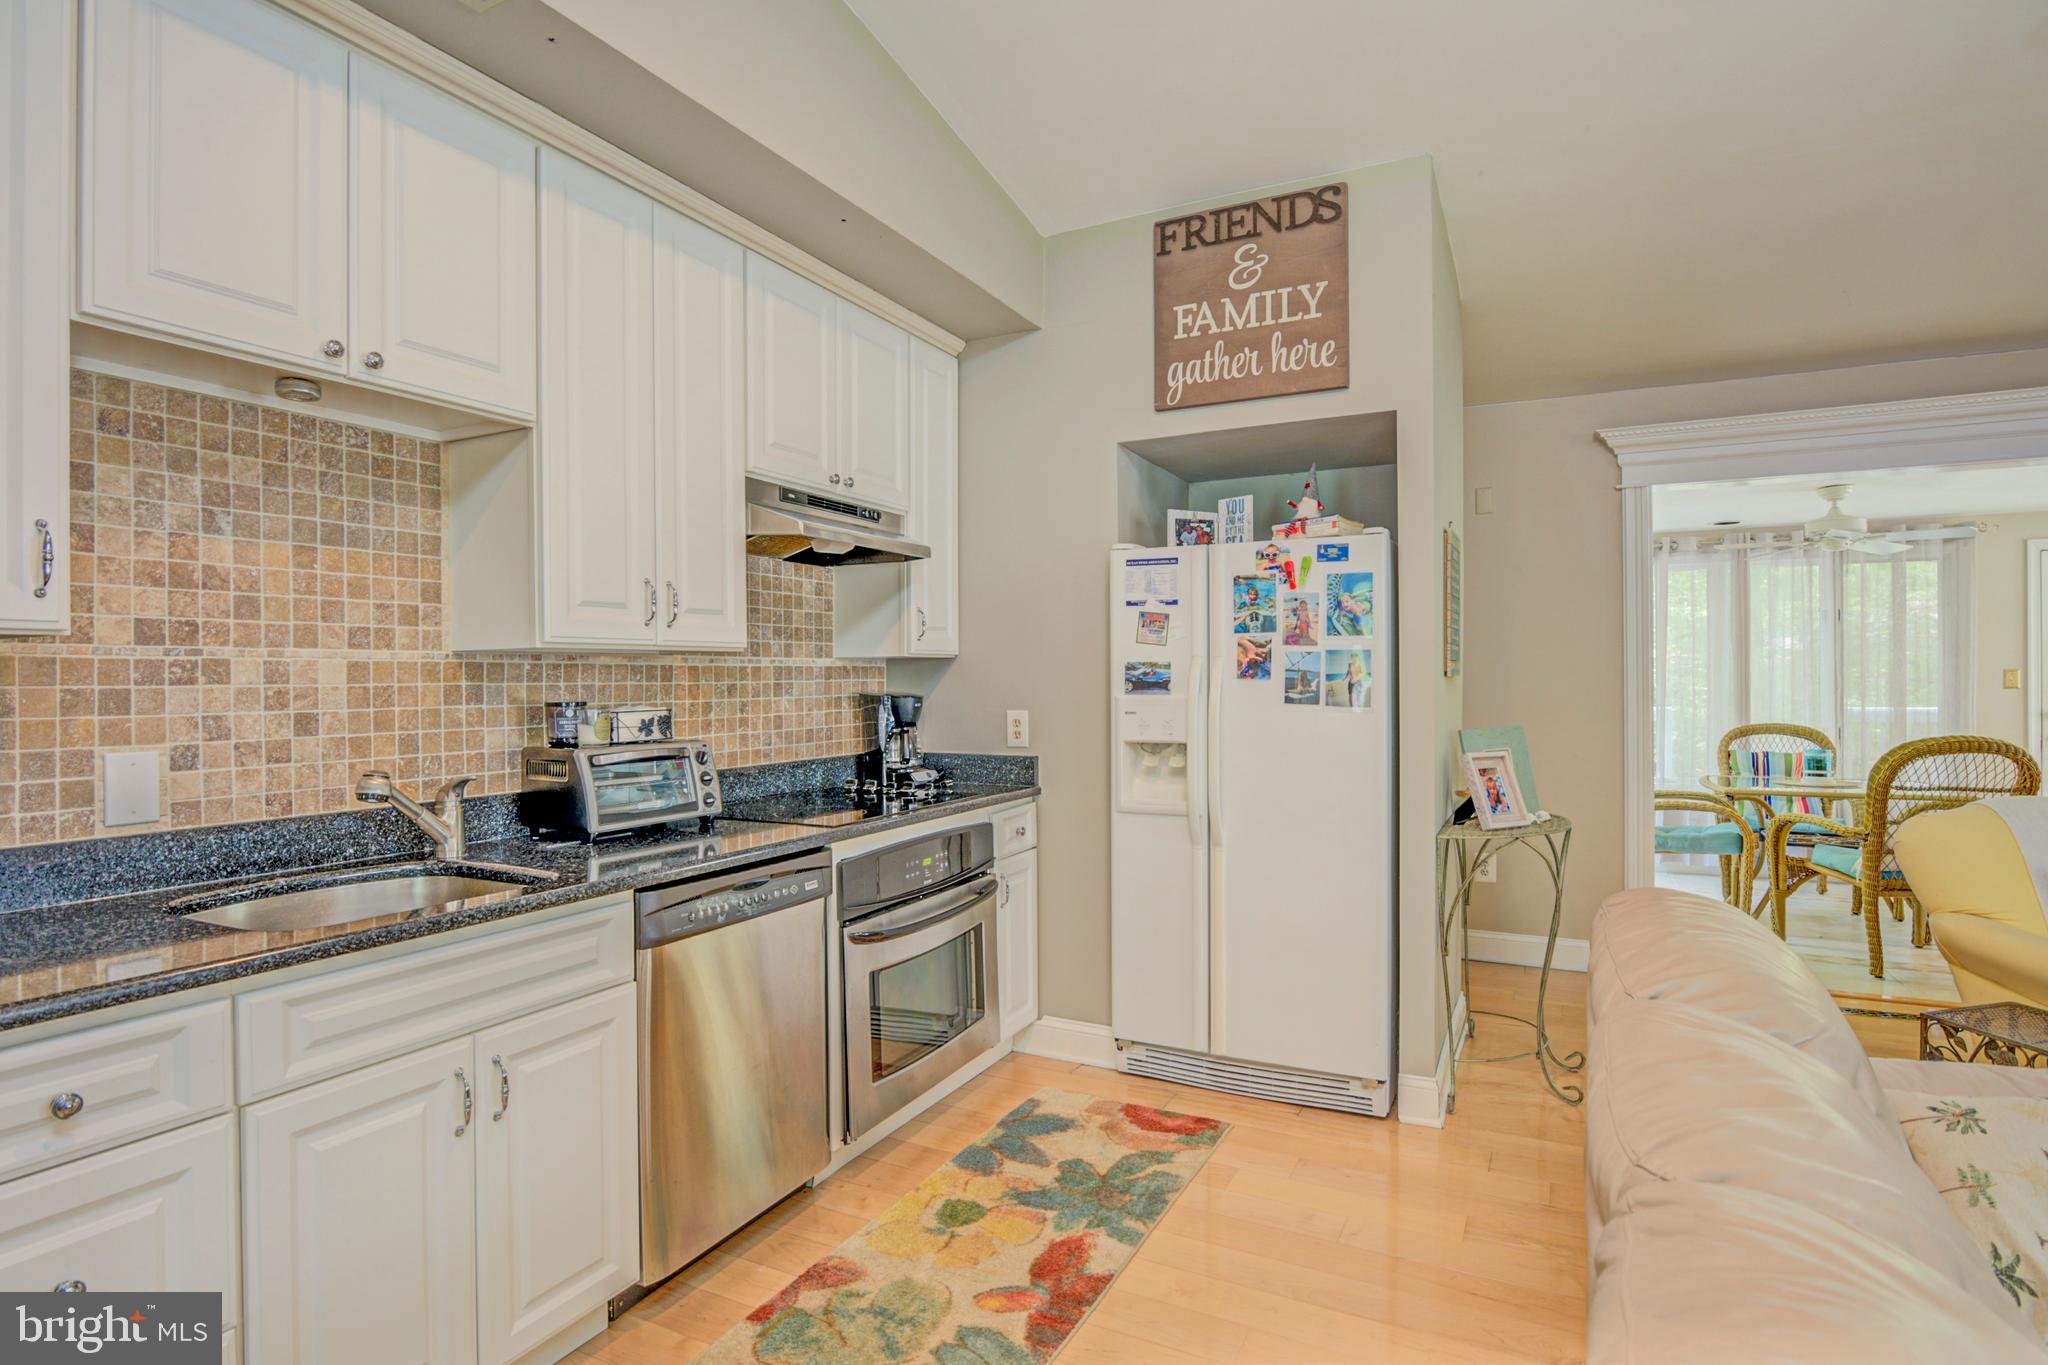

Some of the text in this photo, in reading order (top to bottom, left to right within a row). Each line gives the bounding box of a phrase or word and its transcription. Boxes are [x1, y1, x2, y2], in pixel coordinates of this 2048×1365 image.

[1156, 185, 1342, 256] FRIENDS
[1228, 243, 1269, 290] &
[1173, 281, 1329, 339] FAMILY
[1166, 331, 1337, 405] gather here
[1225, 498, 1245, 515] YOU
